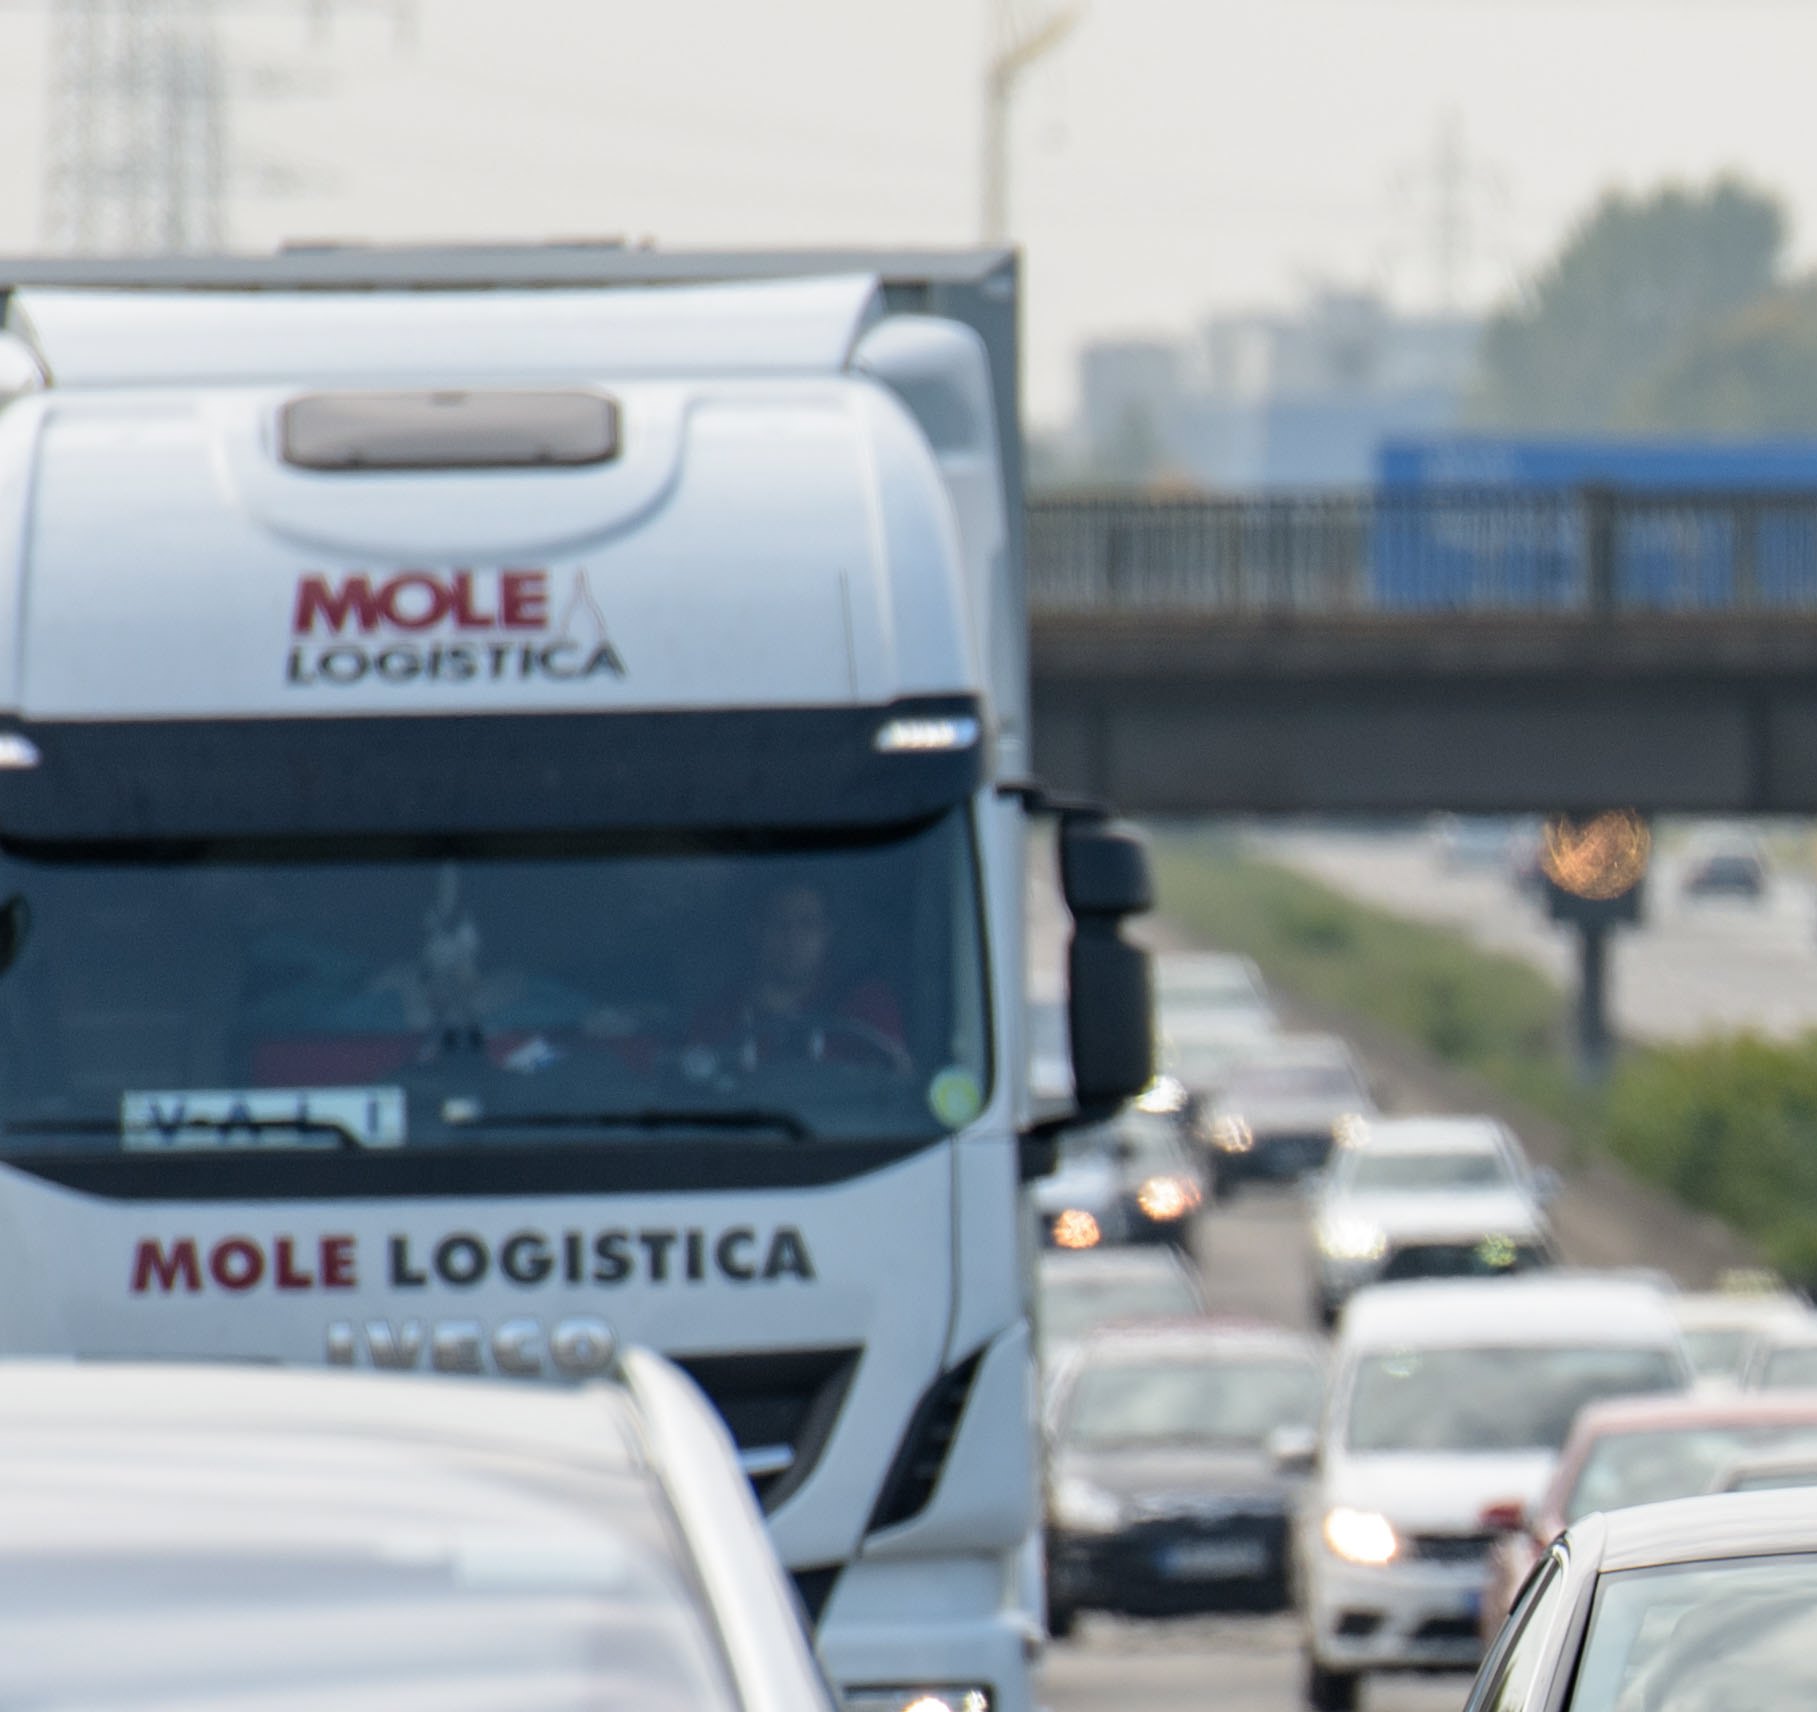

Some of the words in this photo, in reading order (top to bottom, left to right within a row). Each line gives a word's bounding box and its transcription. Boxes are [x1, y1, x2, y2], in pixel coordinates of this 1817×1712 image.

[294, 570, 547, 636] MOLE
[287, 638, 627, 687] LOGISTICA
[131, 1235, 357, 1293] MOLE
[387, 1226, 817, 1289] LOGISTICA
[326, 1315, 616, 1376] IVECO
